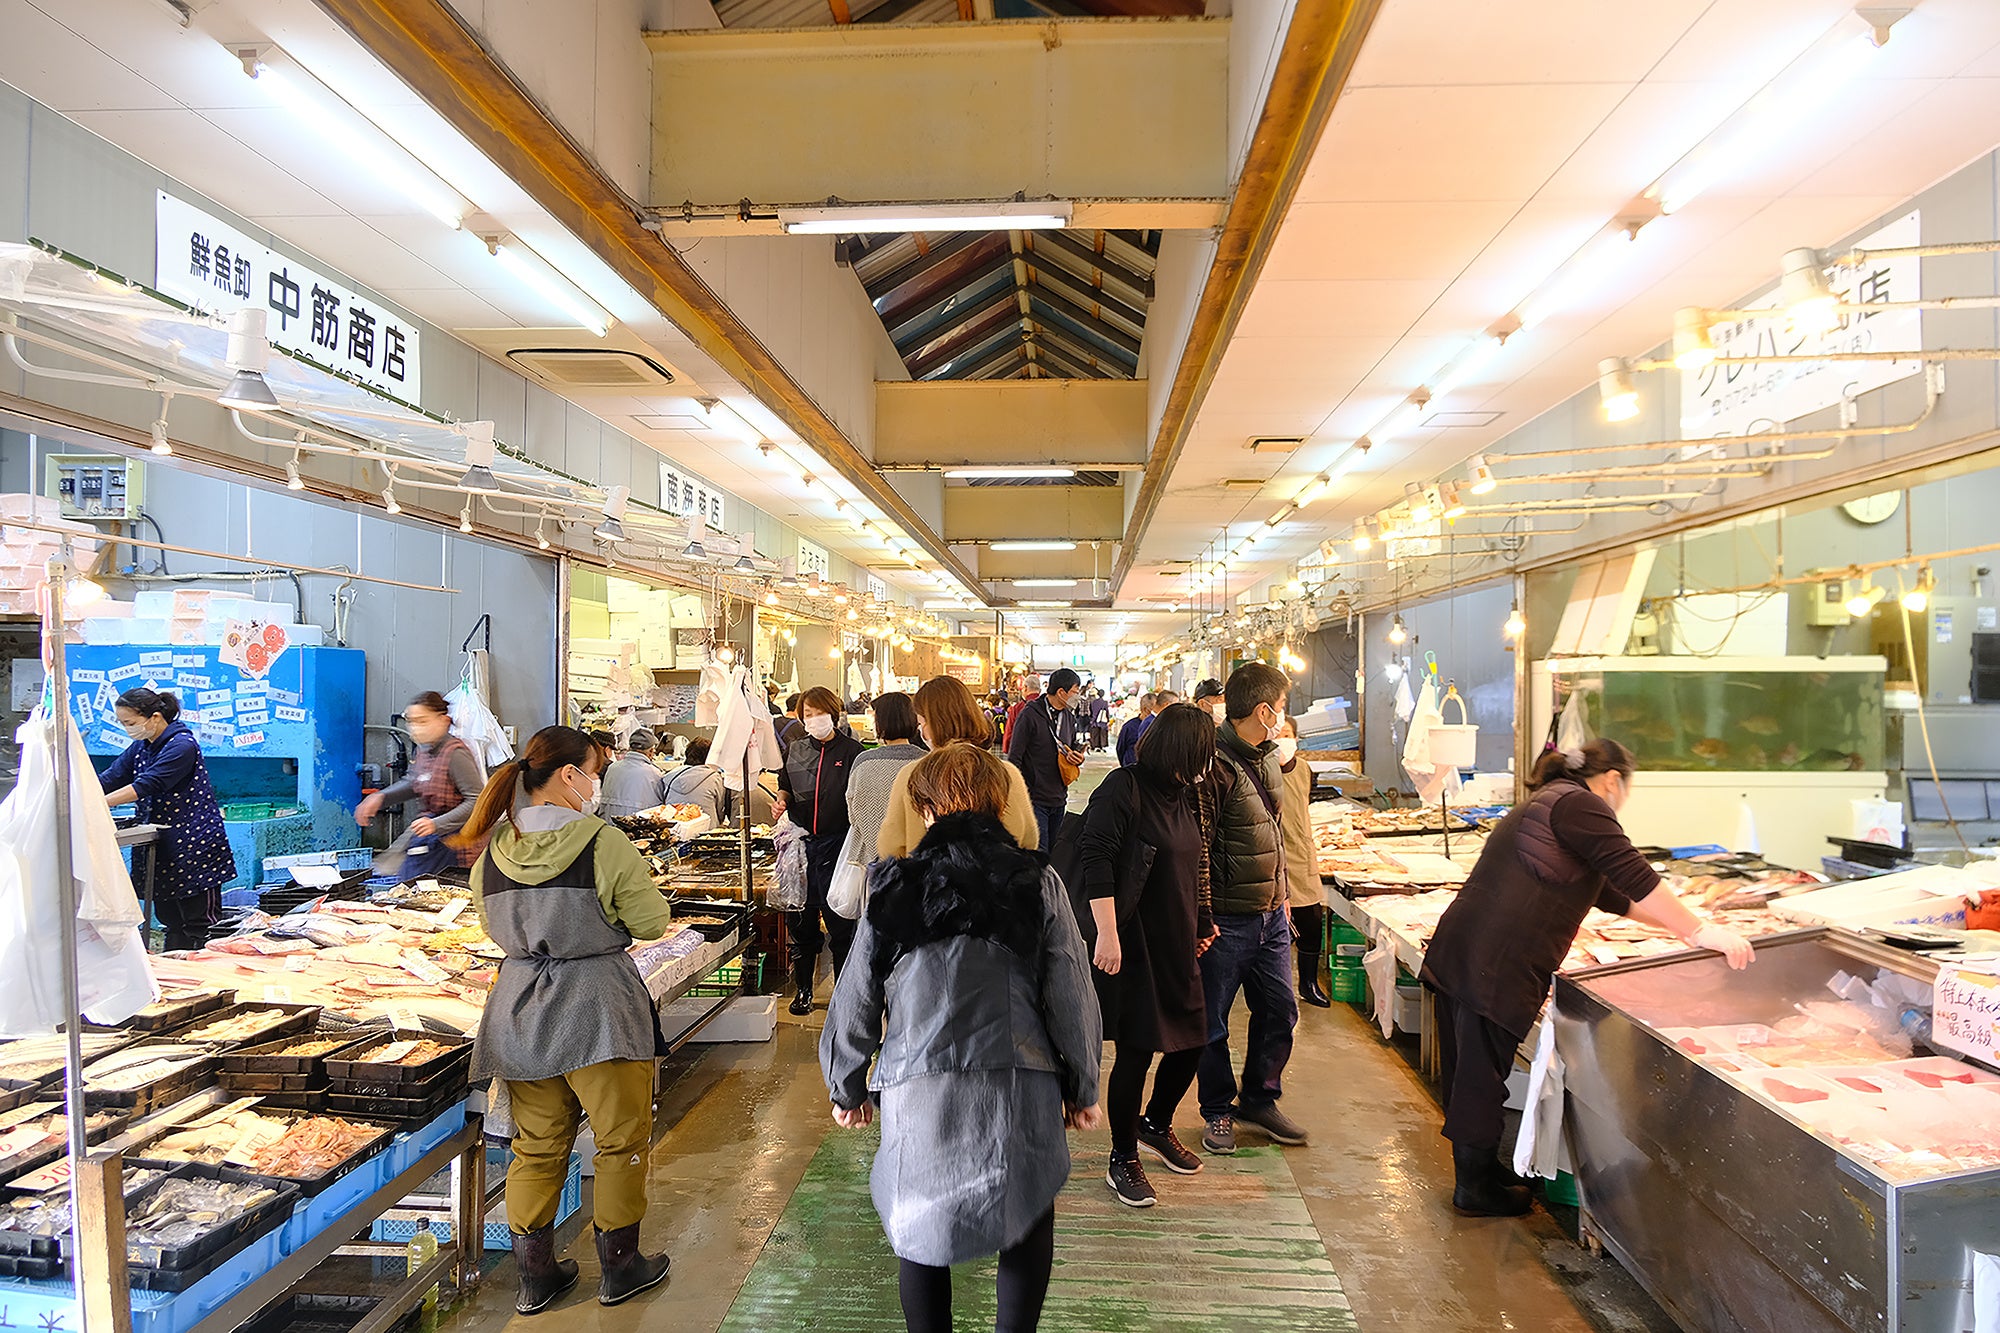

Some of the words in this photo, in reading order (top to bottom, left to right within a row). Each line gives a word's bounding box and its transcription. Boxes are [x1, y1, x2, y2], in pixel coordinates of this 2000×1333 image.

[189, 231, 251, 301] 鮮魚卸
[268, 267, 406, 383] 中筋商店
[667, 472, 720, 526] 南海商店
[1948, 1011, 1996, 1049] 最高級
